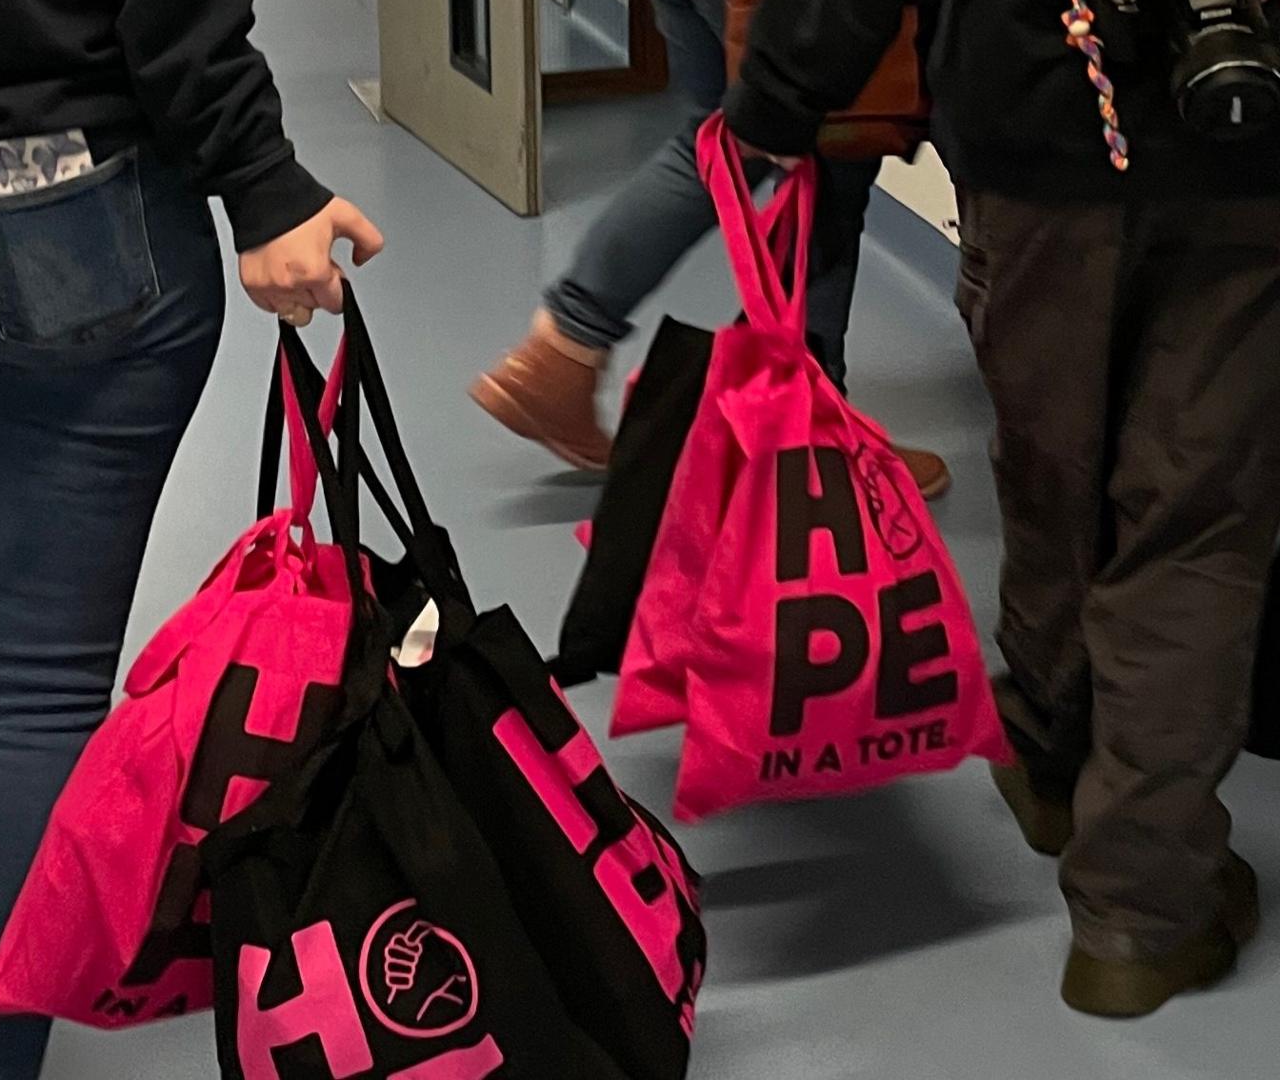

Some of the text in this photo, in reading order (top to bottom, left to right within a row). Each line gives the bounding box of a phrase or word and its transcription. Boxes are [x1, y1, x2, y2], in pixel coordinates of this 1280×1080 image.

[770, 568, 958, 737] PE
[760, 747, 802, 781] IN
[814, 742, 842, 772] A
